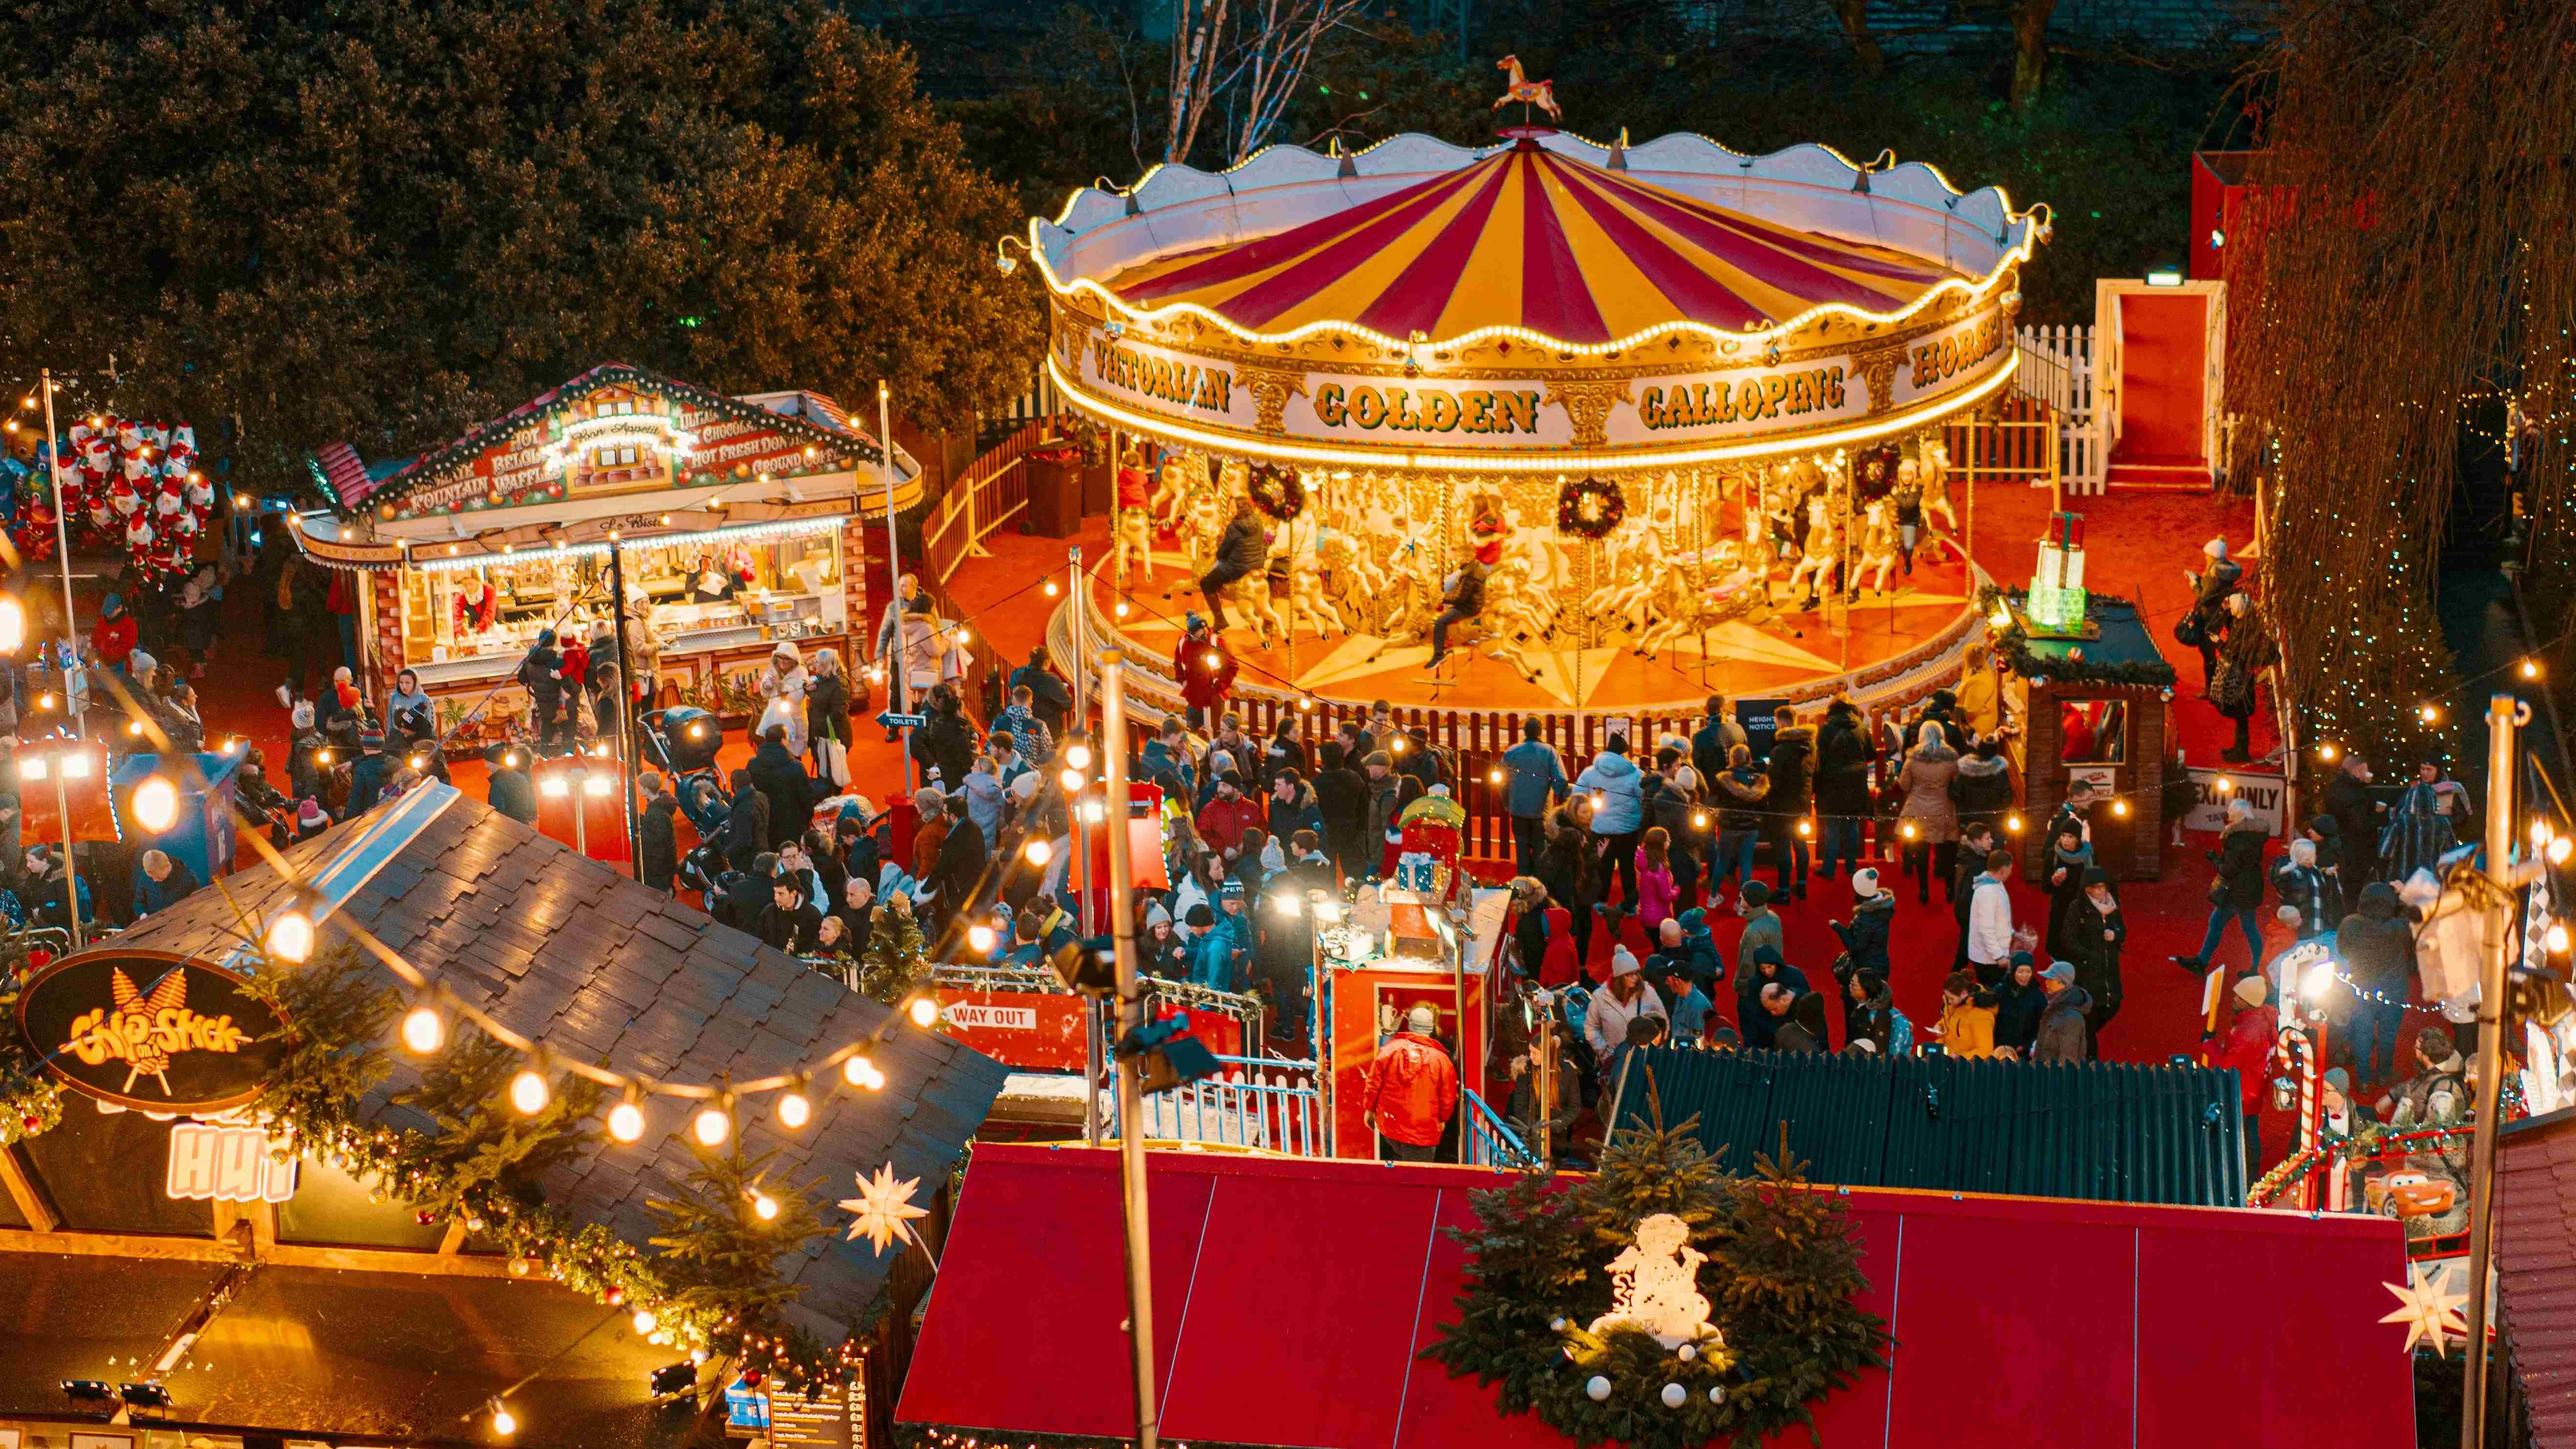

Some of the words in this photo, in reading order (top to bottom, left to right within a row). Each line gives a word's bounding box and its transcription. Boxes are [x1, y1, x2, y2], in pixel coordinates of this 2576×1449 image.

[1912, 311, 2003, 389] HORSES
[1093, 337, 1231, 413] VICTORIAN
[1314, 383, 1540, 433] GOLDEN
[1639, 366, 1845, 429] GALLOPING
[509, 427, 539, 452] HOT
[611, 422, 660, 435] Appetit
[492, 448, 548, 476] BELGI
[692, 449, 717, 468] HOT
[719, 438, 762, 462] FRESH
[753, 453, 801, 473] GROUND
[803, 446, 843, 468] COFF
[410, 475, 489, 515] FOUNTAIN
[626, 515, 664, 529] Bistr
[889, 717, 918, 726] TOILETS
[2234, 786, 2279, 810] ONLY
[953, 1007, 986, 1023] WAY
[994, 1009, 1026, 1025] OUT
[168, 1124, 297, 1203] HUT
